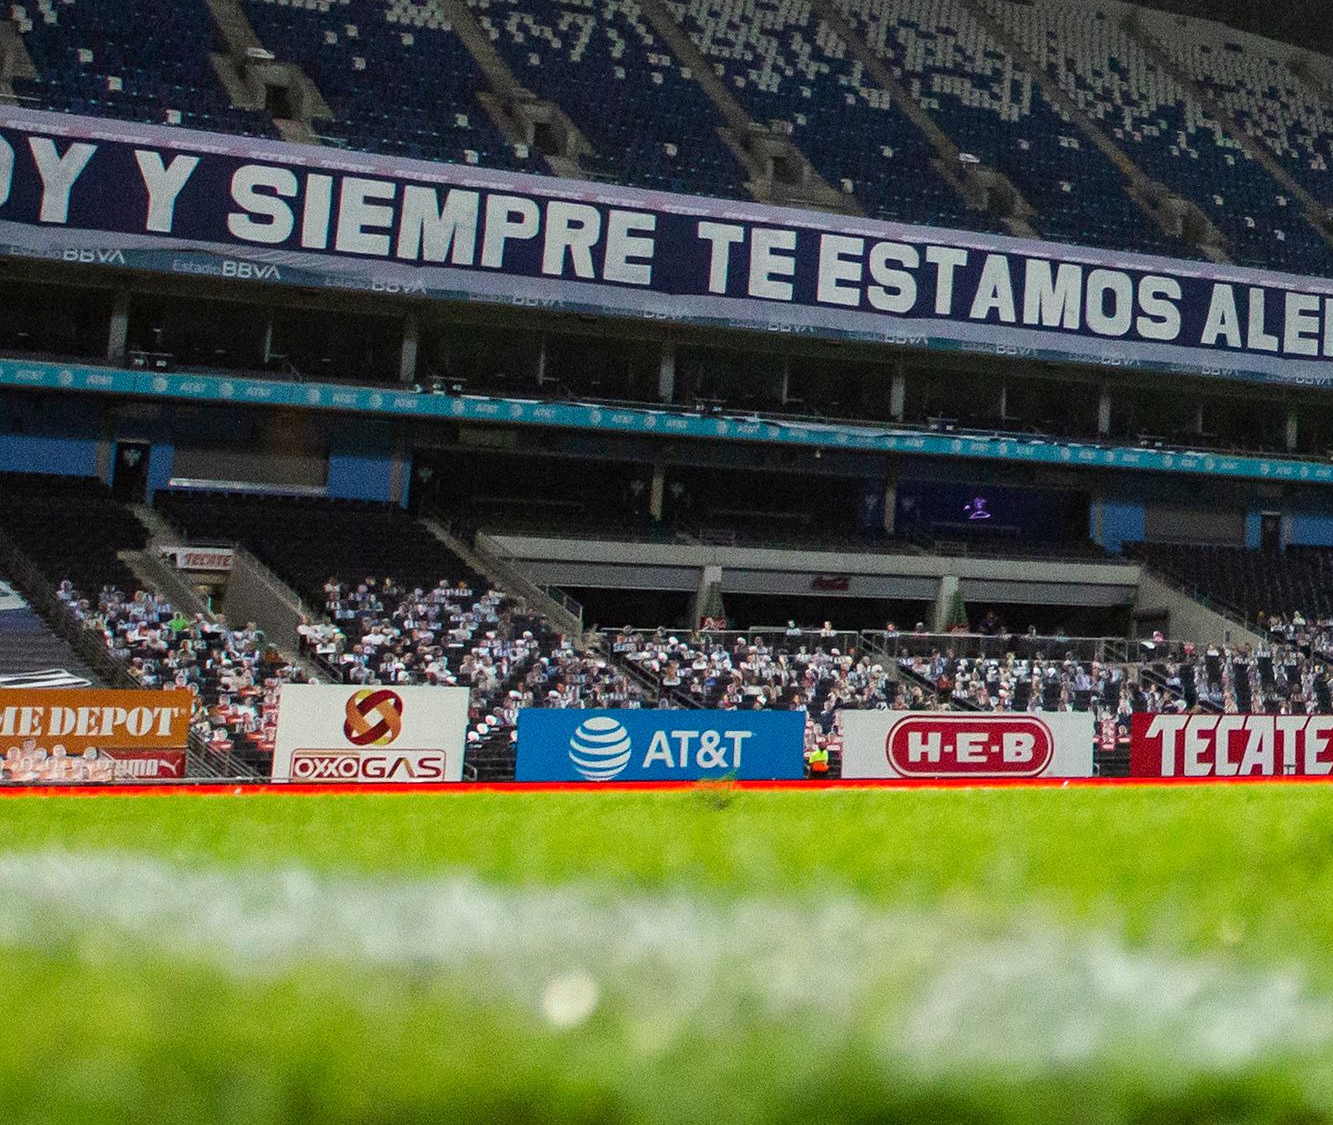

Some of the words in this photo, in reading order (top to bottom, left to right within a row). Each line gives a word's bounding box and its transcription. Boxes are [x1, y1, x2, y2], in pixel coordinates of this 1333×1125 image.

[64, 249, 125, 264] BBVA
[136, 150, 200, 233] Y
[227, 164, 657, 286] SIEMPRE
[698, 222, 797, 301] TE
[816, 233, 1182, 340] ESTAMOS
[221, 260, 281, 280] BBVA
[49, 706, 179, 737] DEPOT
[643, 729, 752, 768] AT&T
[907, 731, 1035, 763] H-E-B
